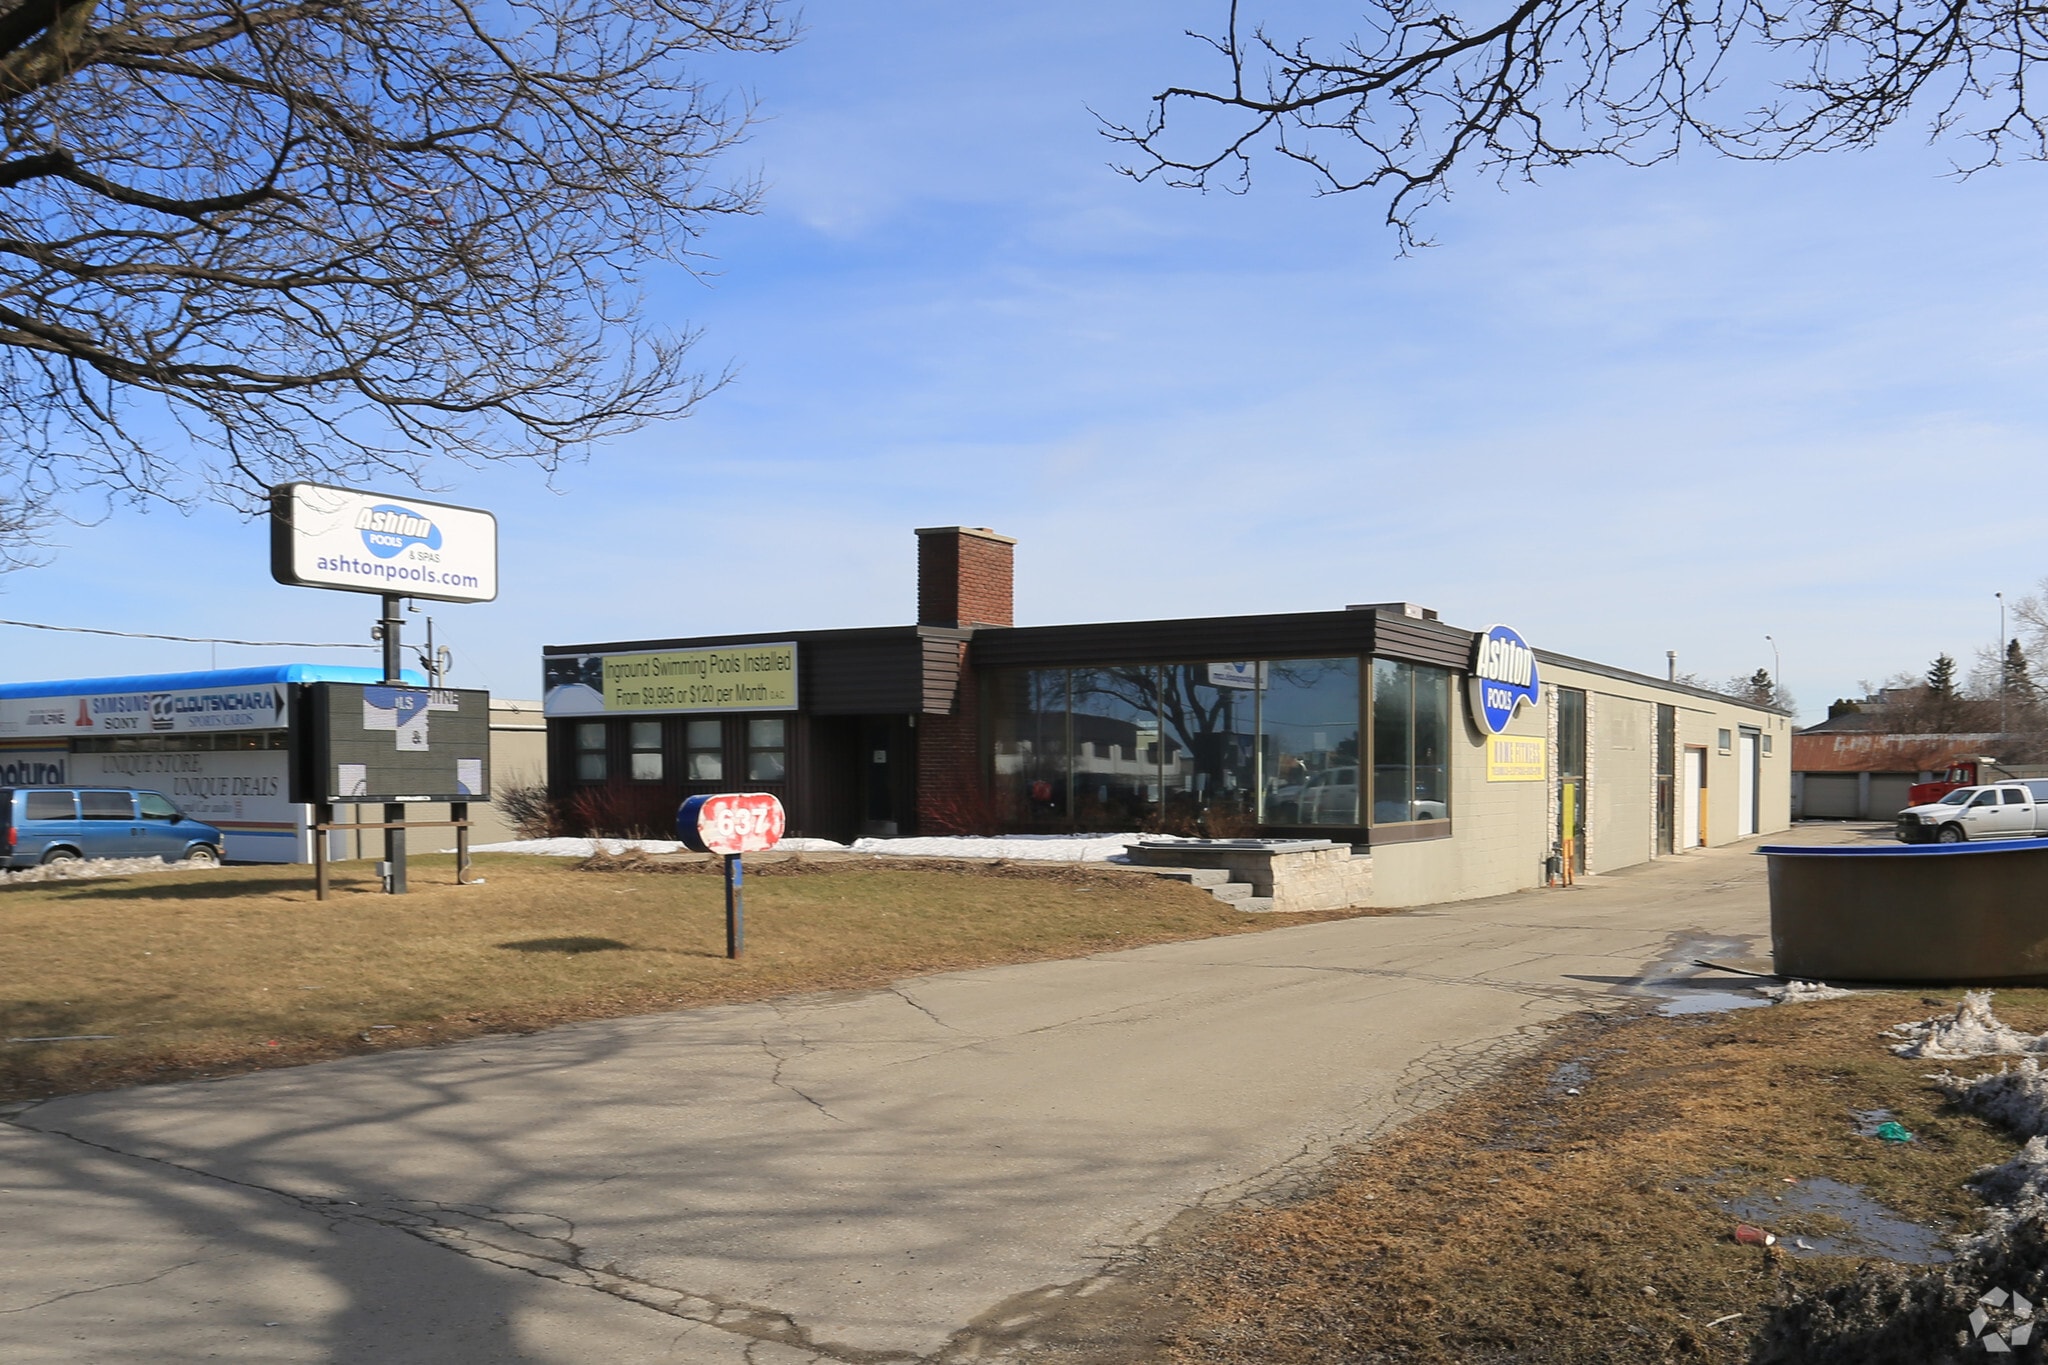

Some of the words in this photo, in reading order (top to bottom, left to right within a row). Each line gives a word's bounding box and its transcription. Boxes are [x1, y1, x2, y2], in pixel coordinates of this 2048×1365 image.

[355, 507, 432, 538] Ashton
[370, 534, 403, 548] POOLS
[418, 551, 441, 563] SPAS
[317, 555, 479, 588] ashtonpools.com
[605, 658, 649, 682] Inground
[652, 656, 706, 679] Swimming
[710, 653, 741, 674] Pools
[744, 650, 791, 672] Installed
[1476, 633, 1533, 686] Ashton
[93, 695, 149, 713] SAMSUNG
[616, 688, 640, 706] From
[677, 690, 687, 704] or
[690, 685, 713, 704] $120
[716, 687, 733, 706] per
[736, 683, 767, 702] Month
[1488, 688, 1512, 711] POOLS
[105, 717, 139, 729] SONY
[188, 714, 221, 728] SPORTS
[223, 713, 254, 726] CARDS
[102, 754, 152, 776] UNIQUE
[174, 776, 229, 799] UNIQUE
[231, 776, 279, 797] DEALS
[718, 808, 769, 836] 637
